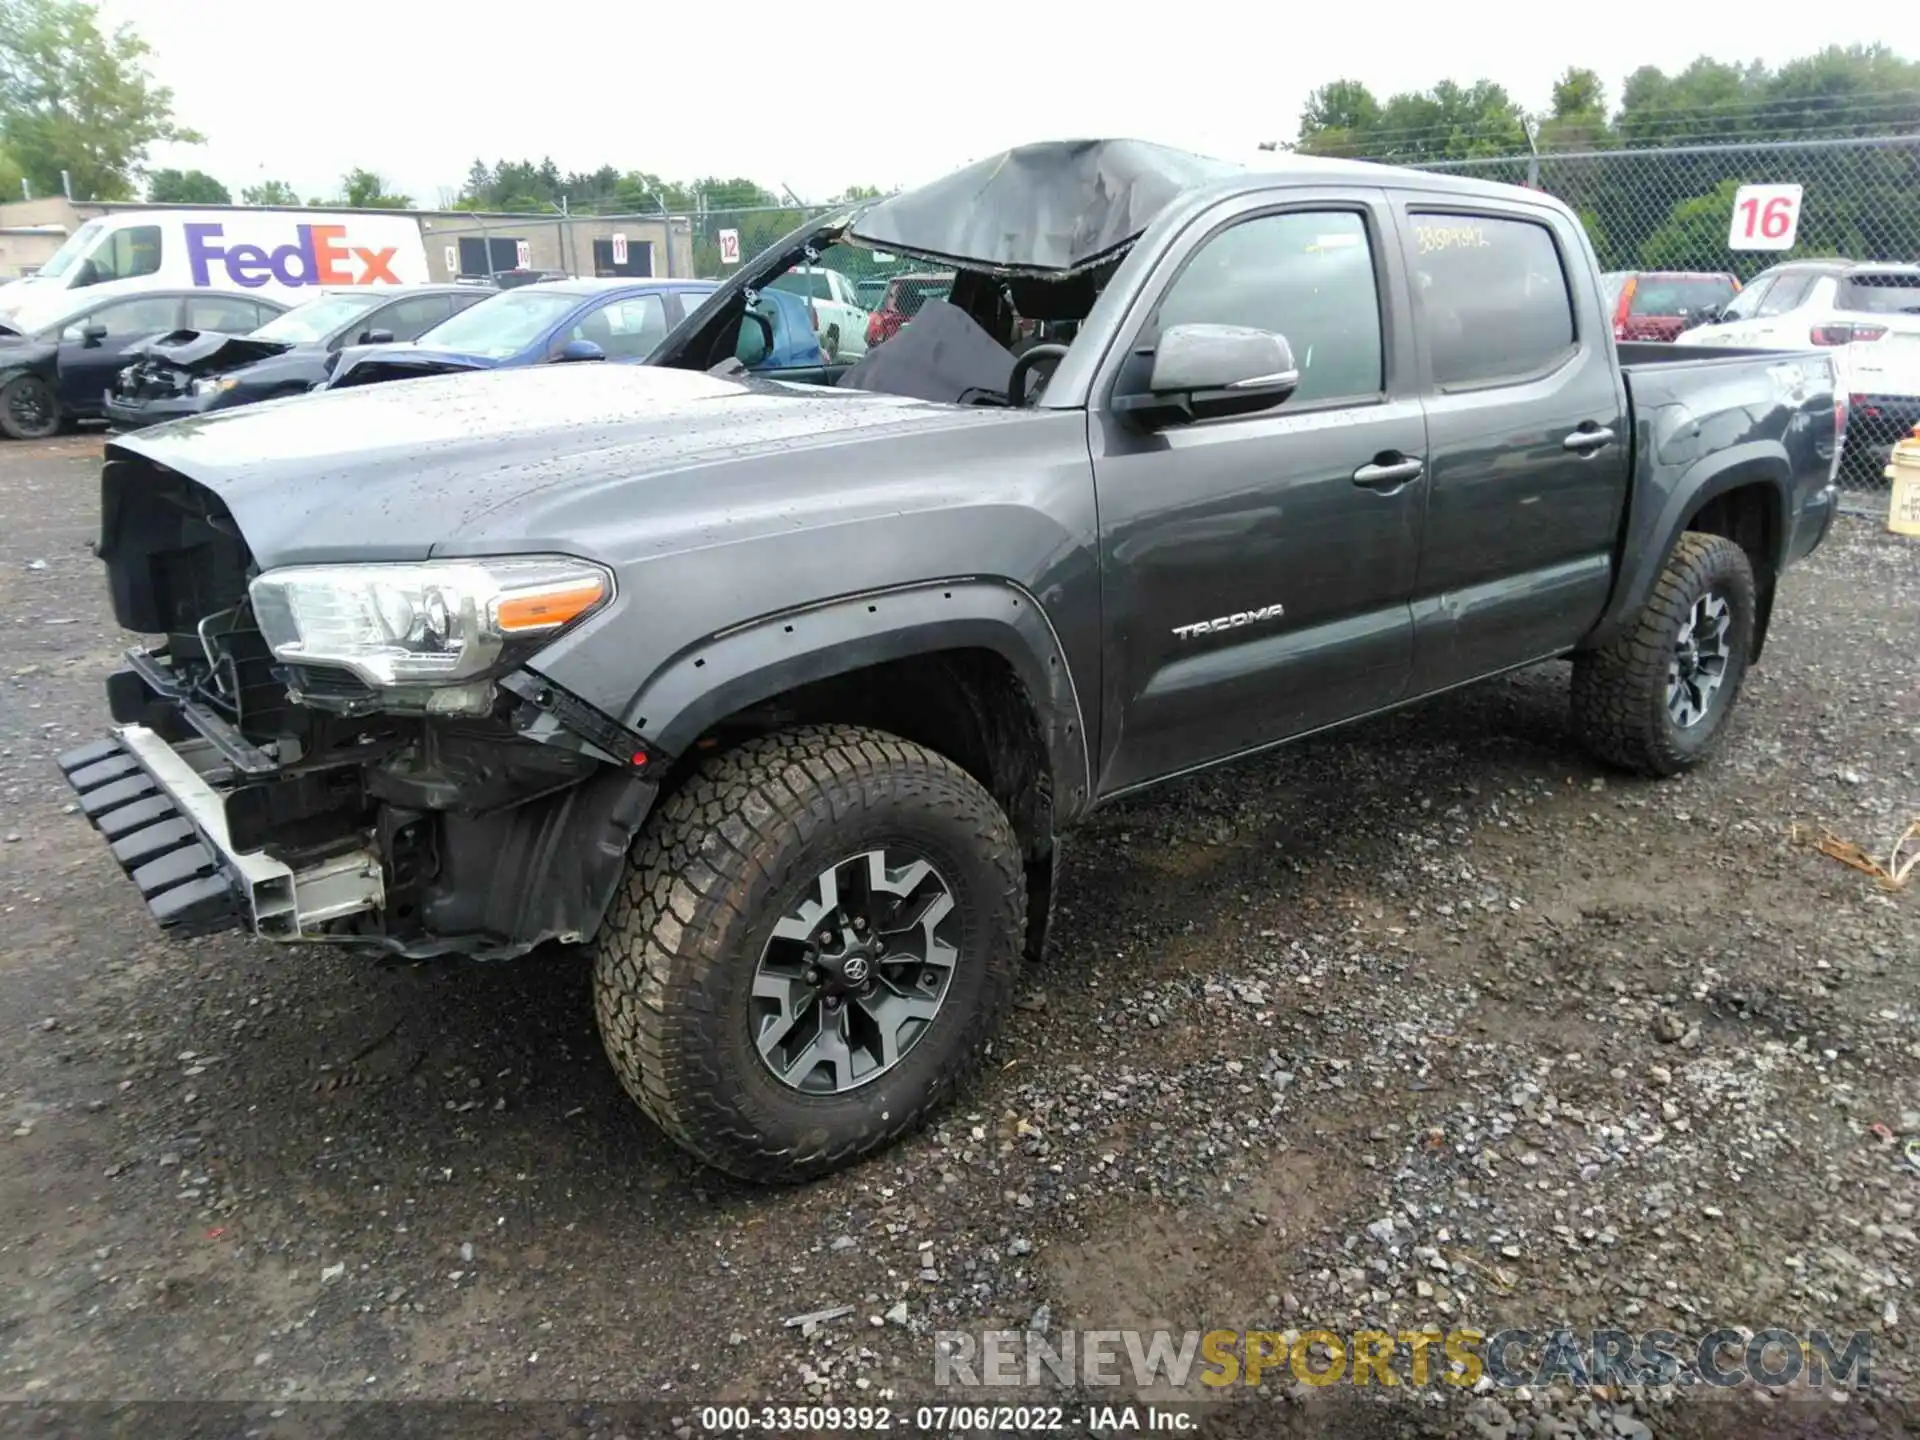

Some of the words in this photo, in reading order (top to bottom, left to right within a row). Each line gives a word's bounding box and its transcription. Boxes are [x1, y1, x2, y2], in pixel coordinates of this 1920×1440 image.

[1739, 196, 1793, 239] 16
[182, 222, 403, 288] FedEx
[614, 239, 626, 259] 11
[721, 235, 738, 258] 12
[1171, 603, 1285, 640] TACOMA
